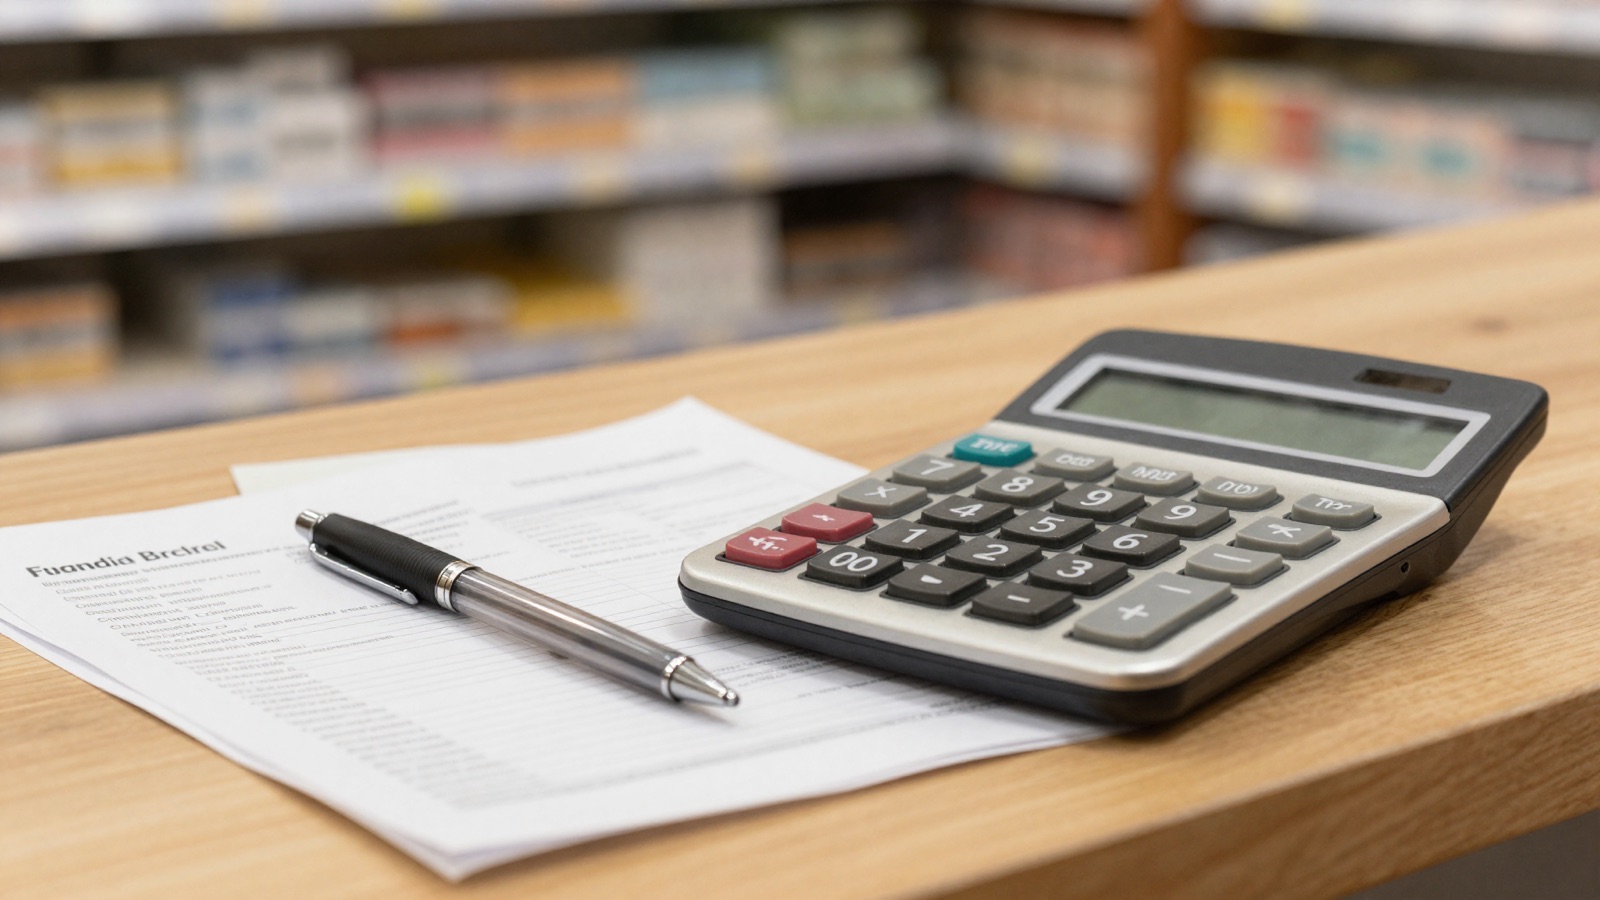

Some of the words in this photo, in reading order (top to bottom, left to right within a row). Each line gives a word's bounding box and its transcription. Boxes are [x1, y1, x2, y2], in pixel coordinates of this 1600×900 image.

[1001, 475, 1035, 493] 8
[1080, 489, 1114, 506] 9
[949, 503, 984, 518] 4
[1163, 504, 1197, 520] 9
[1029, 516, 1066, 533] 5
[901, 528, 928, 544] 1
[1112, 533, 1149, 550] 6
[829, 551, 879, 572] 00
[972, 544, 1009, 562] 2
[1056, 559, 1094, 578] 3
